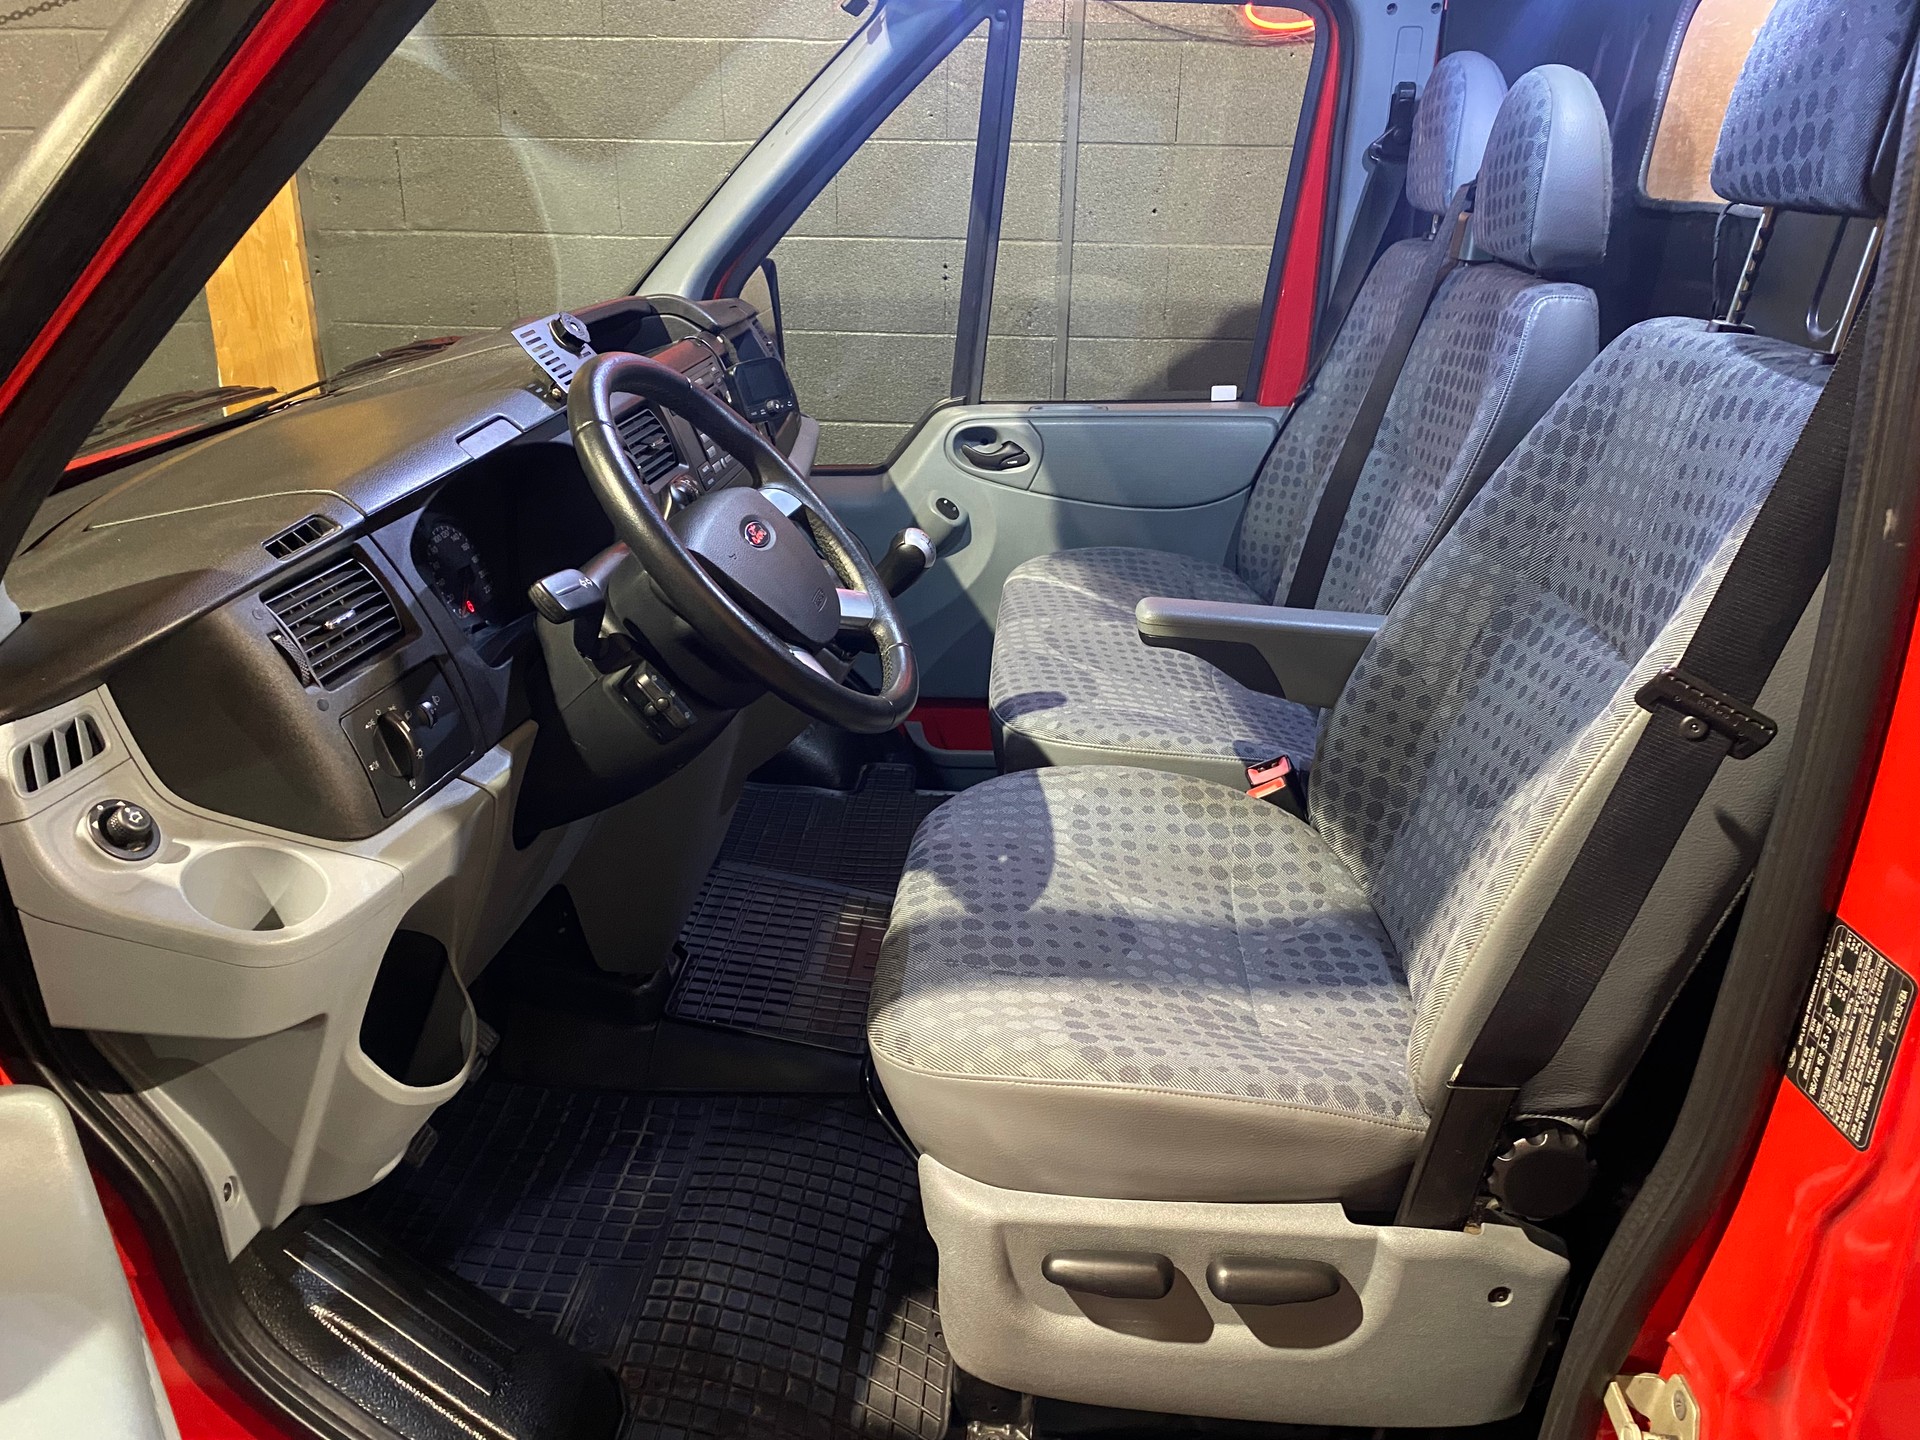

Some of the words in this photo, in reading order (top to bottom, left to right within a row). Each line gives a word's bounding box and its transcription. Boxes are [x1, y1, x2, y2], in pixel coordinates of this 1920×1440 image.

[1825, 951, 1835, 970] LOAD
[1865, 1066, 1874, 1083] TYRE
[1870, 1047, 1879, 1065] CARE
[1875, 1021, 1887, 1045] ADVICE
